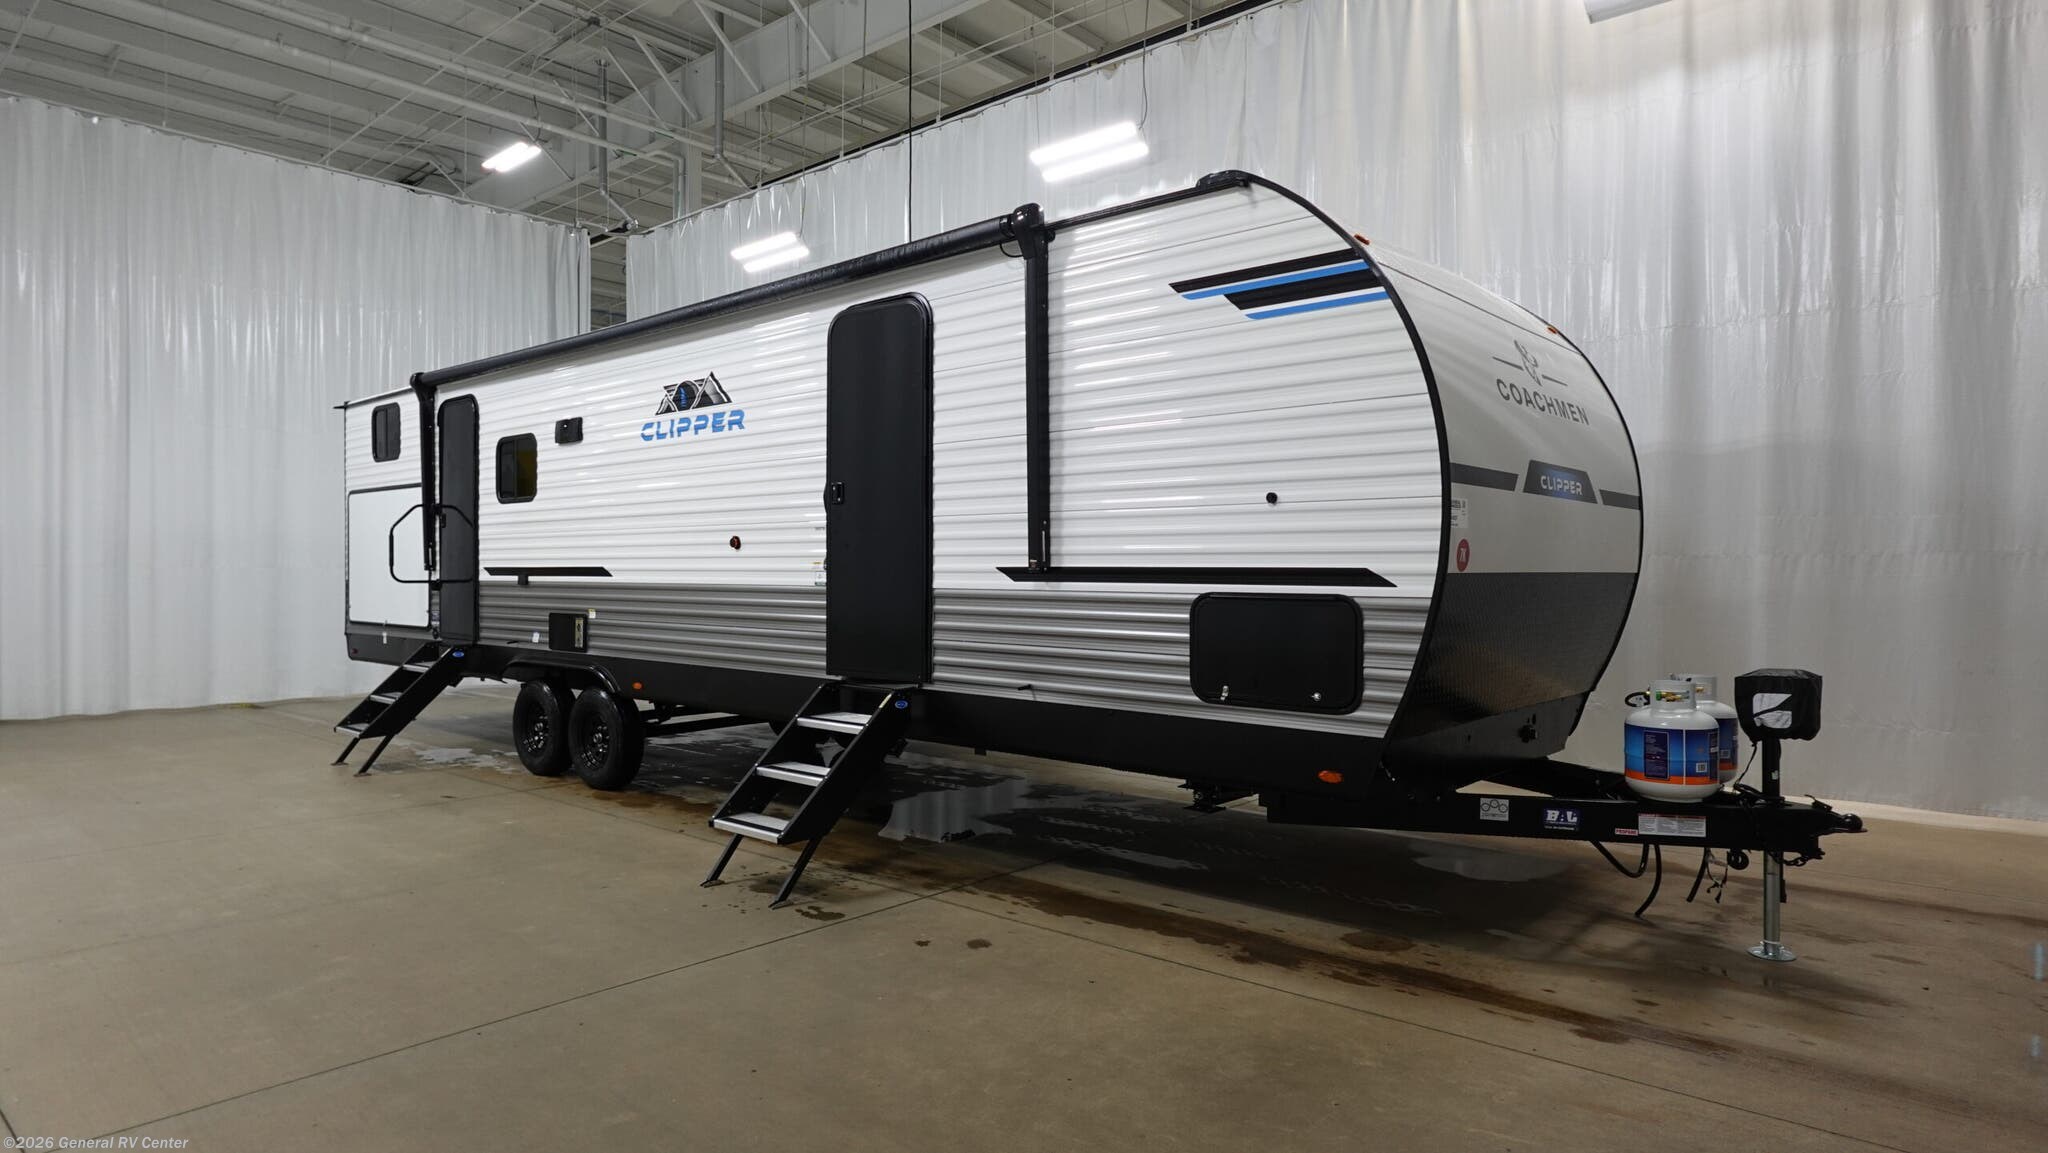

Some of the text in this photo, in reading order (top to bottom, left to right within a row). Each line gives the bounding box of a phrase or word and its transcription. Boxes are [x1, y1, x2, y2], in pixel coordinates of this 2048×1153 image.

[1496, 378, 1590, 426] COACHMEN
[640, 409, 746, 442] CLIPPER
[1540, 475, 1583, 496] CLIPPER
